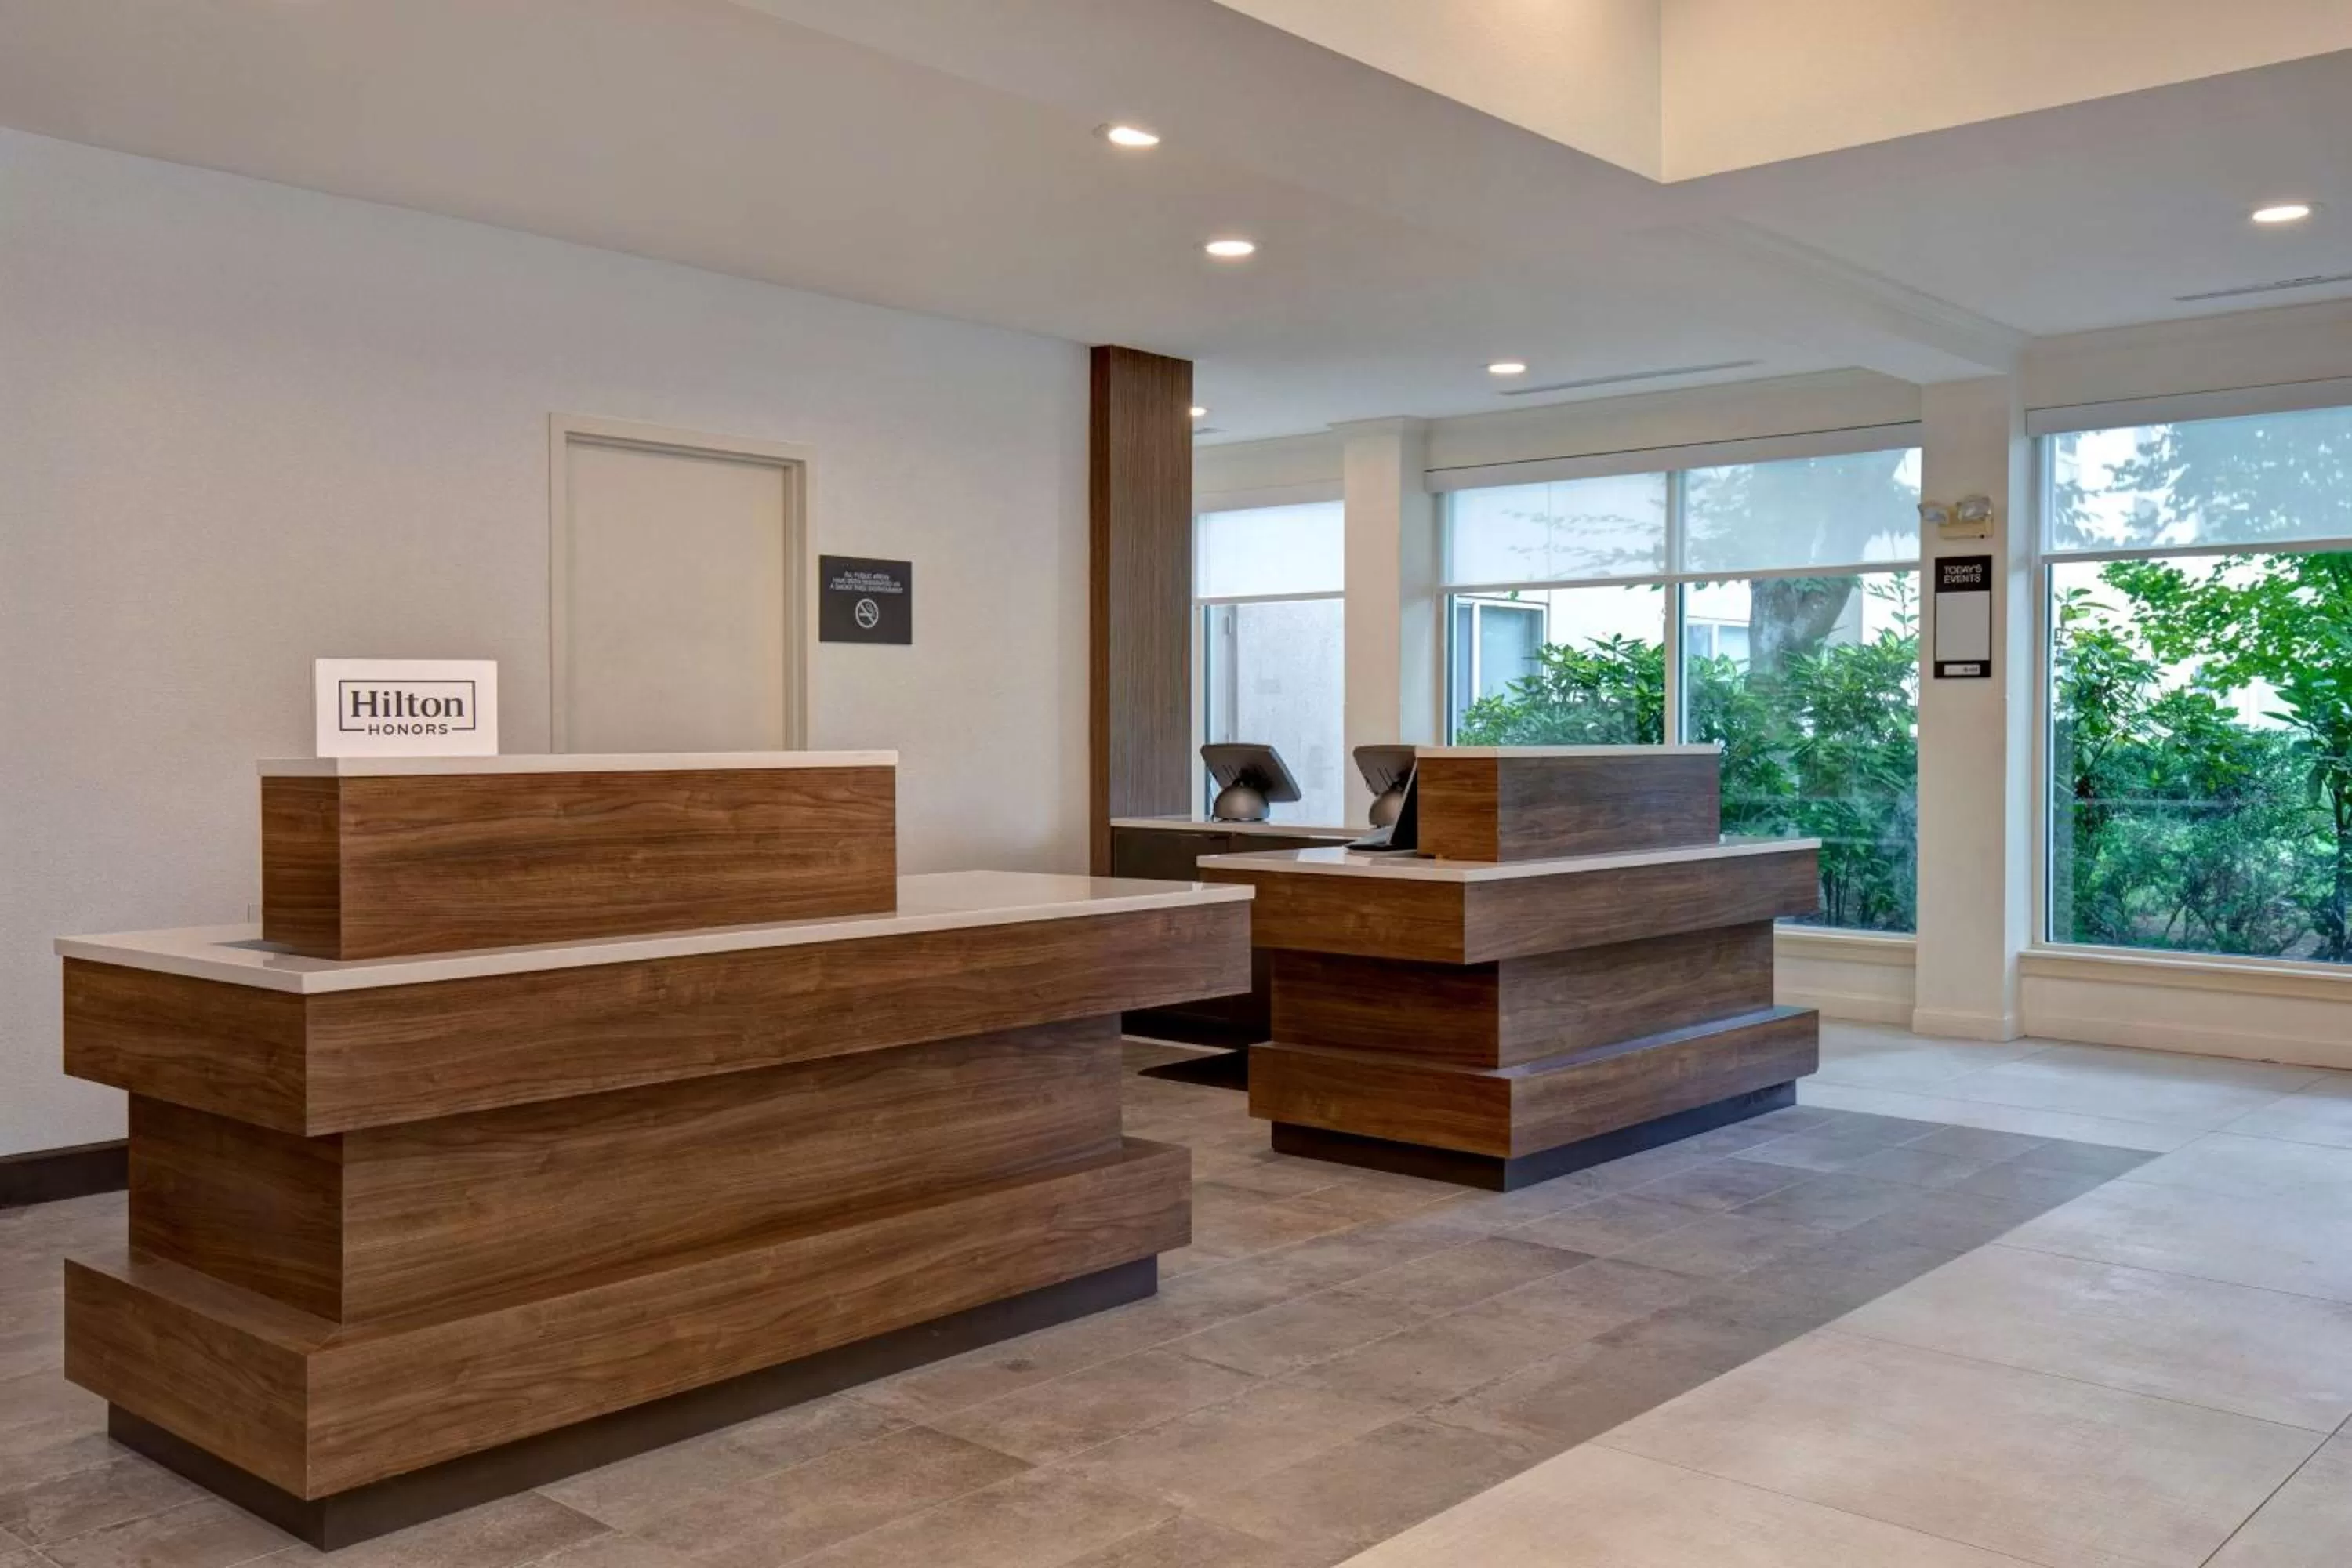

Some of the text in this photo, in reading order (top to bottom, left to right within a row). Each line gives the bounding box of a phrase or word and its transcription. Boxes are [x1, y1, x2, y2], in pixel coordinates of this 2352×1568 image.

[1944, 564, 1982, 575] TODAY'S
[1944, 573, 1981, 584] EVENTS
[351, 691, 464, 717] Hilton
[368, 724, 448, 735] HONORS
